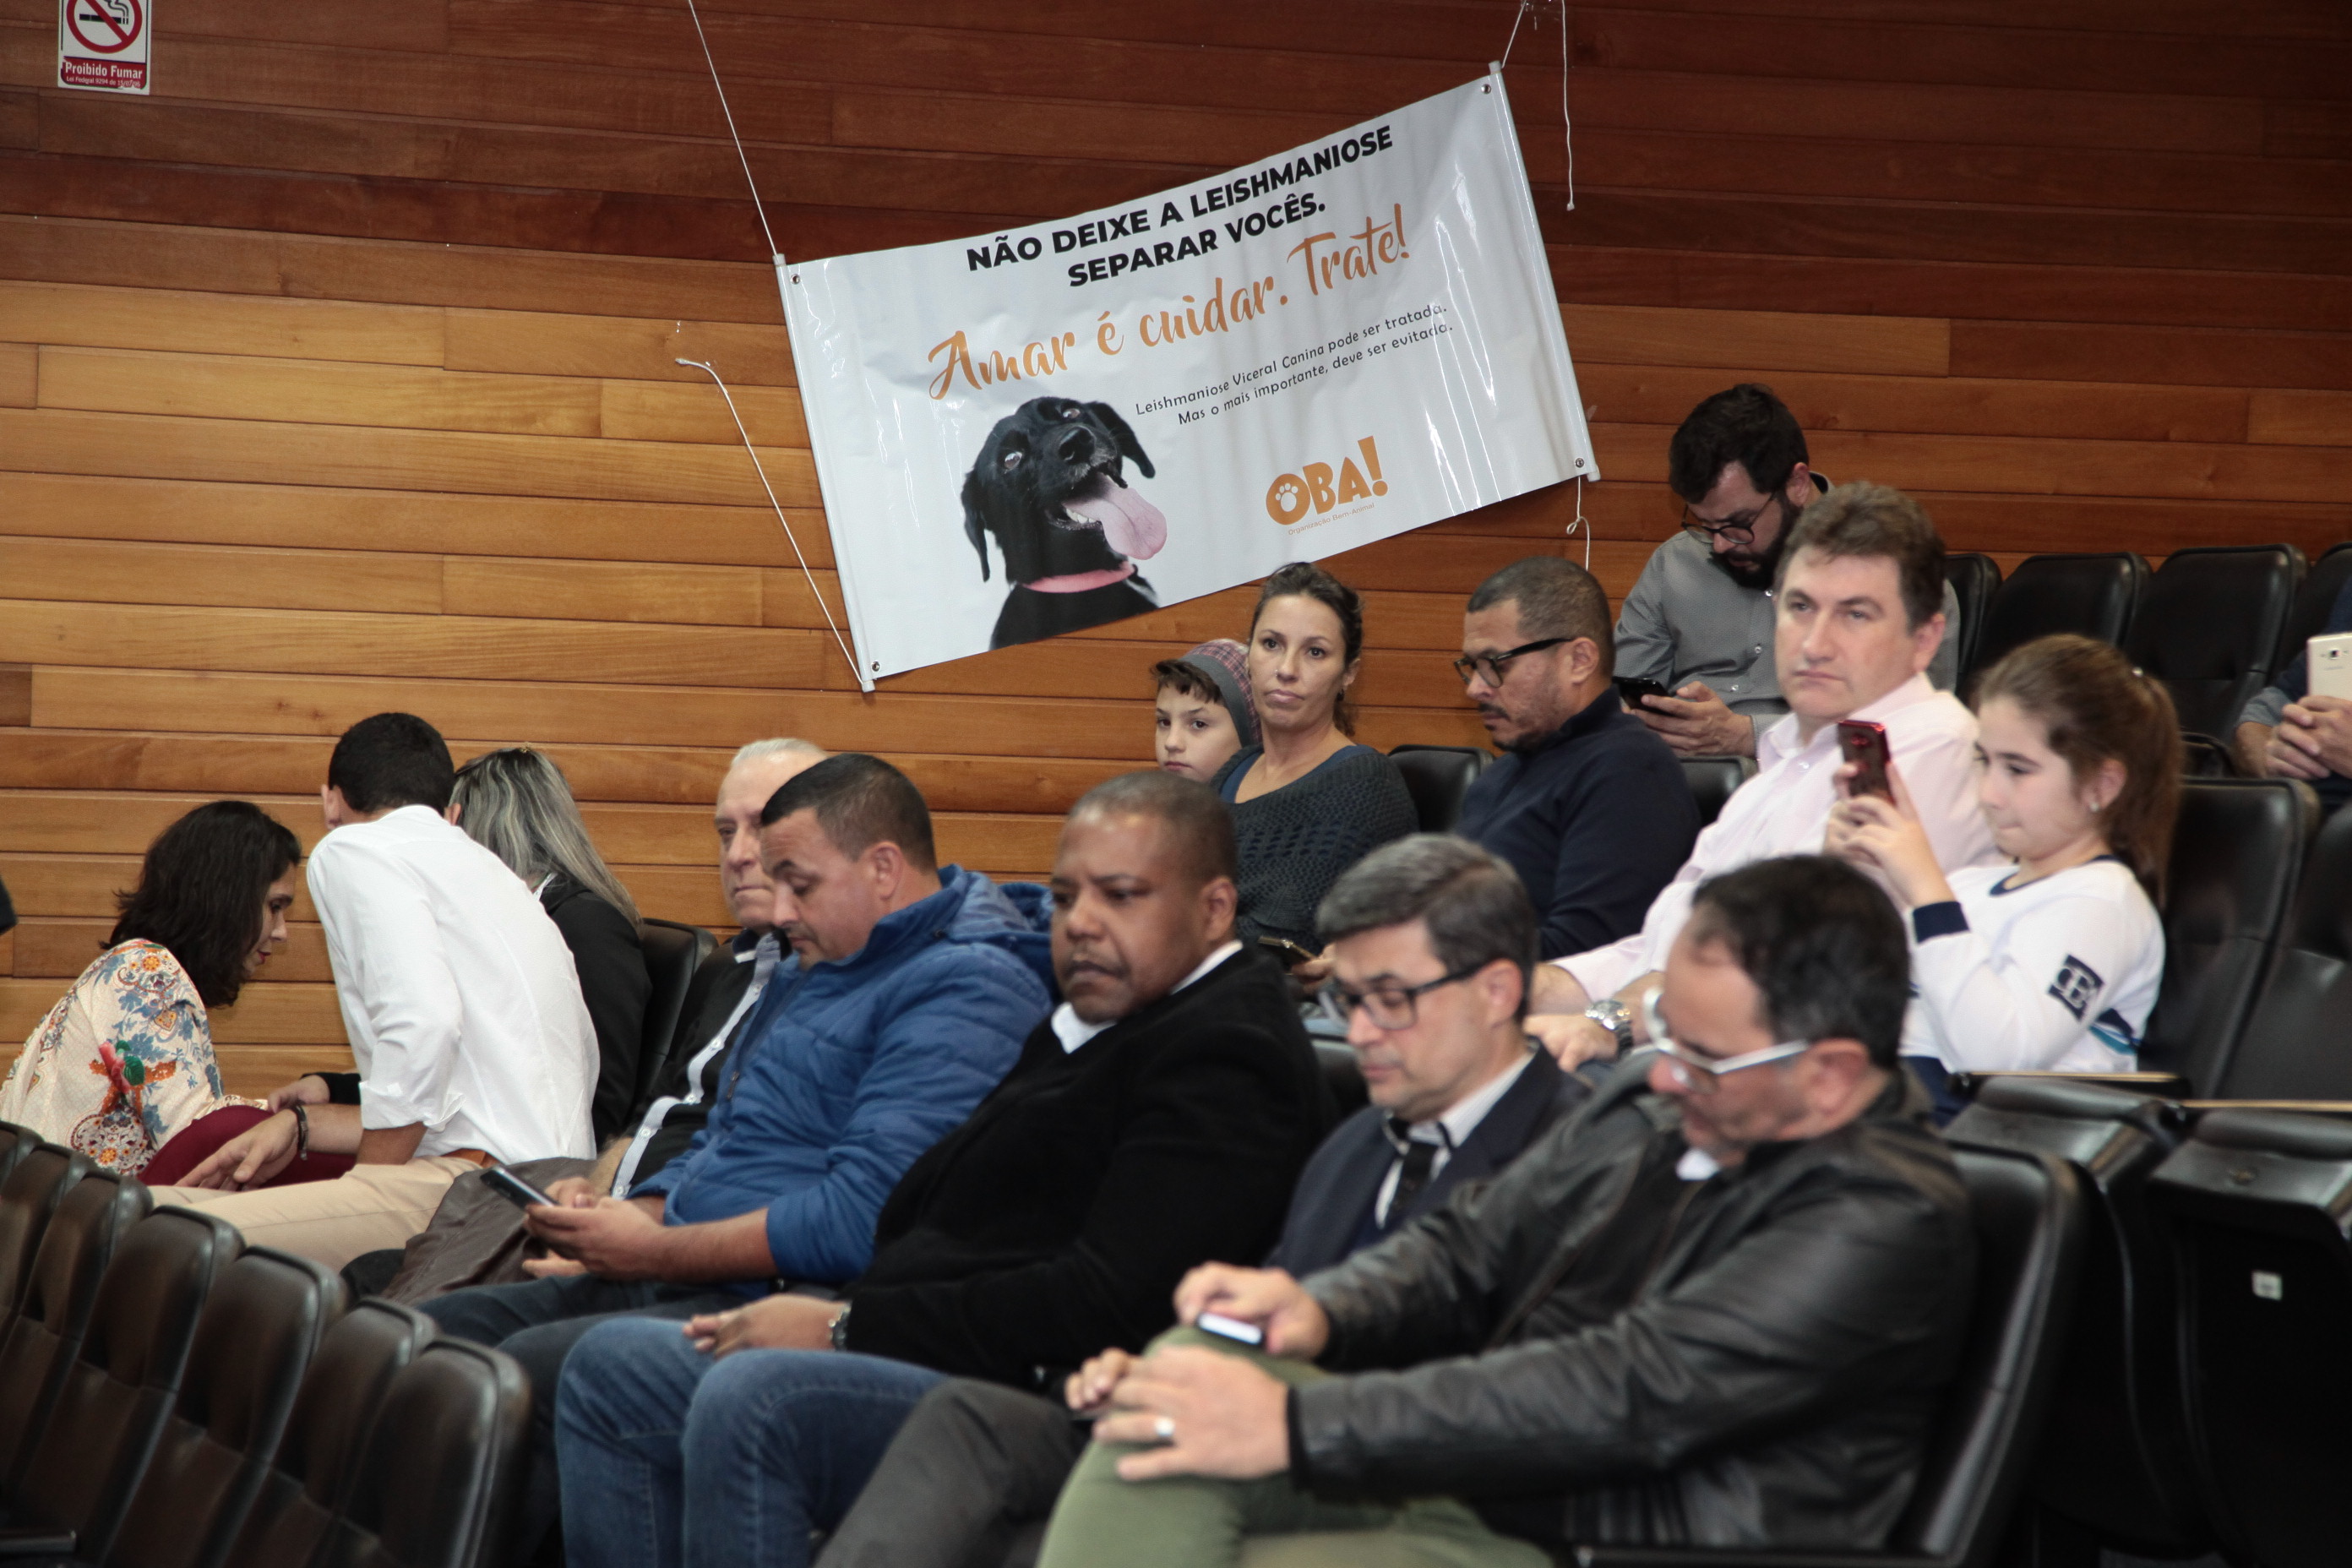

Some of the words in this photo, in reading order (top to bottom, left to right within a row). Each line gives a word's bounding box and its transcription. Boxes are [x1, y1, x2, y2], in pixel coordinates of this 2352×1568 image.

[65, 62, 107, 76] Proibido
[111, 65, 143, 79] Fumar
[966, 235, 1043, 271] NÃO
[1052, 209, 1151, 253] DEIXE
[1160, 201, 1184, 228] A
[1190, 125, 1392, 218] LEISHMANIOSE
[1068, 229, 1218, 287] SEPARAR
[1224, 193, 1326, 243] VOCÊS.
[928, 330, 1075, 400] Amar
[1097, 312, 1124, 356] é
[1140, 277, 1288, 347] cuidar.
[1287, 203, 1409, 296] Trate!
[1135, 381, 1229, 415] Leishmaniose
[1233, 361, 1277, 385] Viceral
[1282, 346, 1324, 369] Canina
[1328, 331, 1358, 353] pode
[1363, 324, 1380, 338] ser
[1386, 304, 1447, 330] tratada.
[1178, 409, 1206, 425] Mas
[1211, 406, 1219, 415] o
[1223, 392, 1250, 411] mais
[1254, 366, 1328, 395] importante,
[1332, 350, 1364, 369] deve
[1367, 342, 1386, 357] ser
[1391, 324, 1453, 349] evitada.
[1266, 435, 1388, 525] OBA!
[1288, 517, 1331, 536] Organização
[1332, 503, 1375, 521] Bem-Animal
